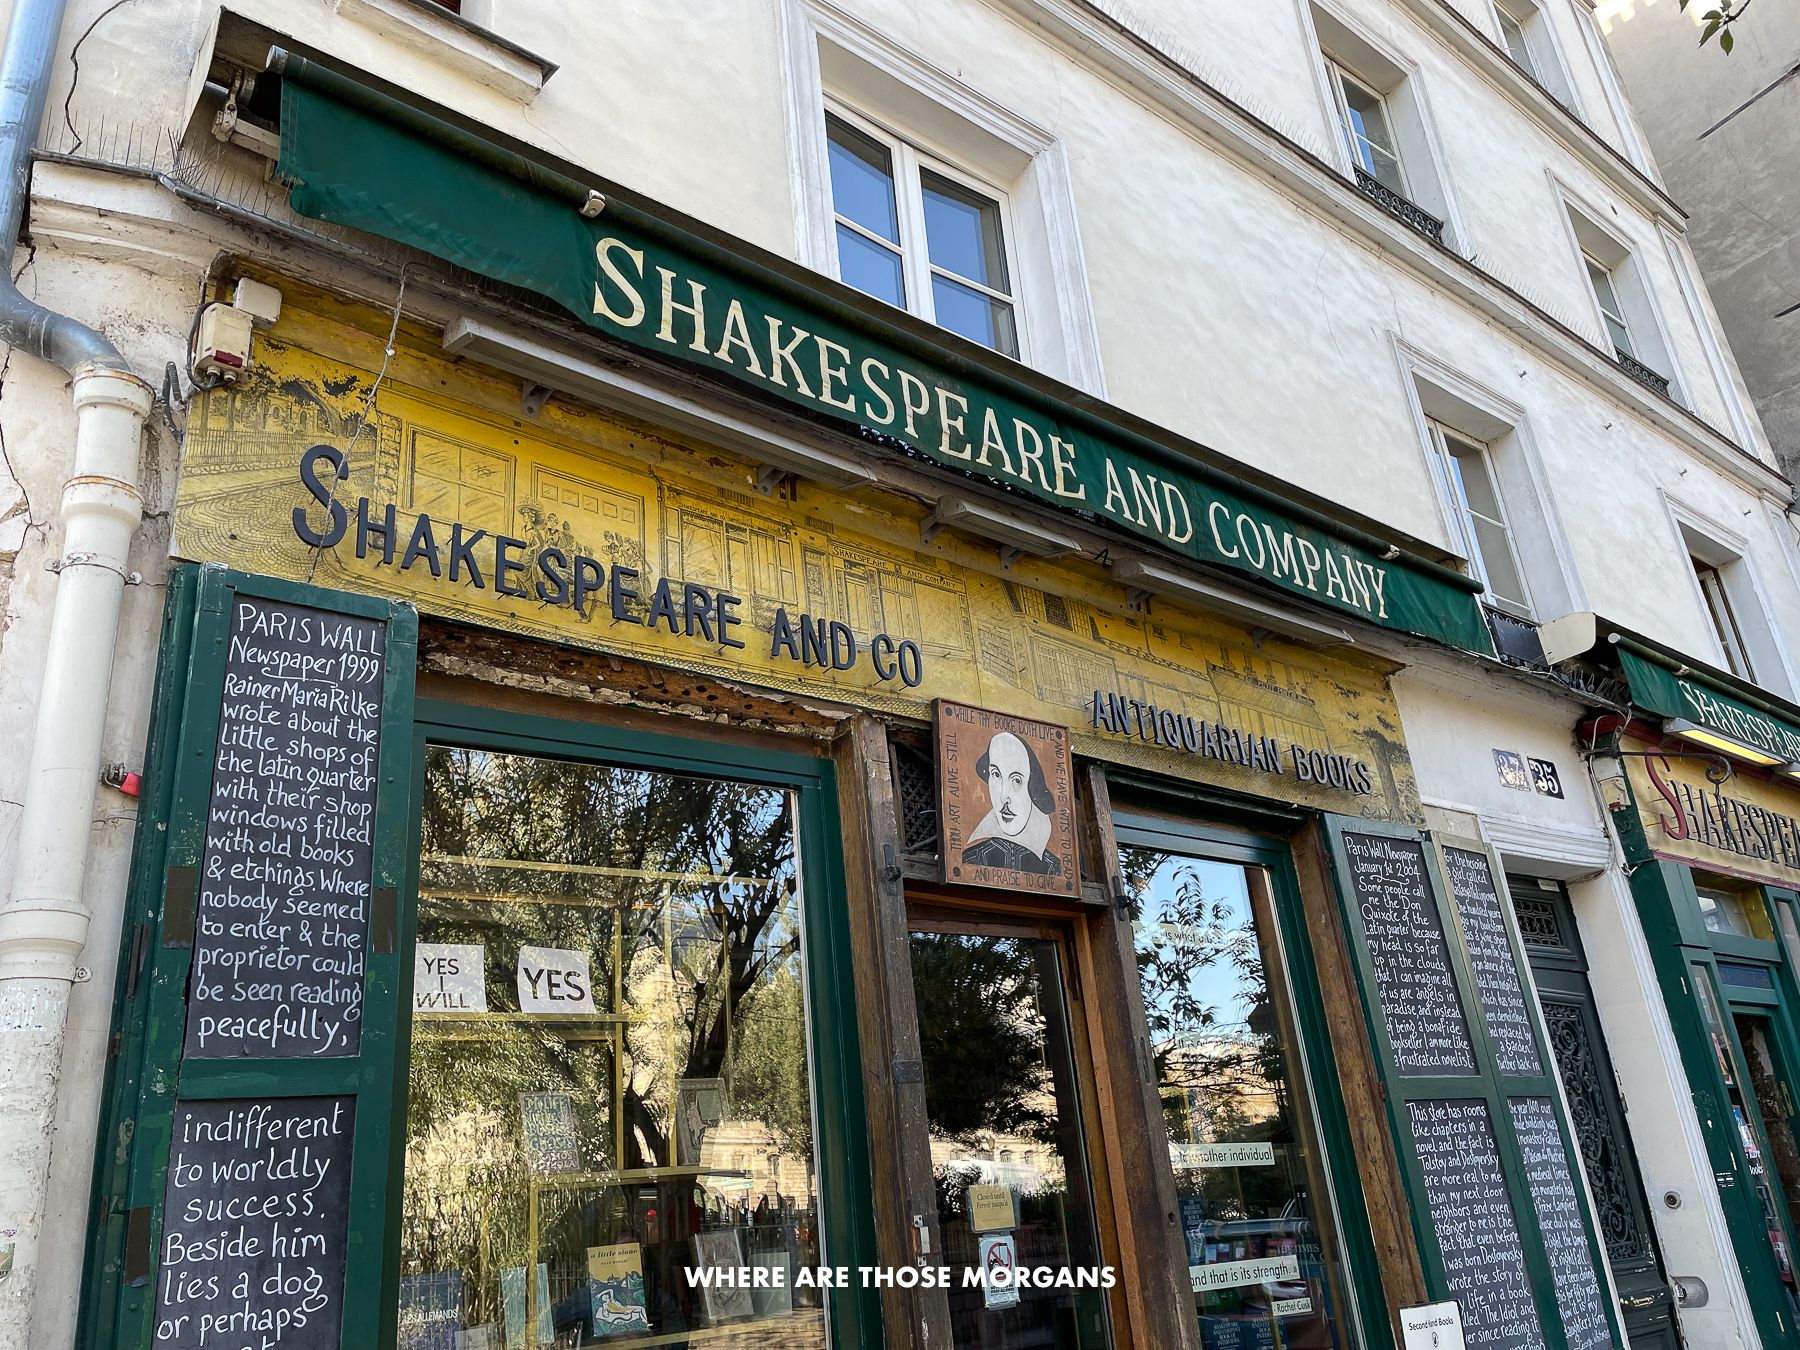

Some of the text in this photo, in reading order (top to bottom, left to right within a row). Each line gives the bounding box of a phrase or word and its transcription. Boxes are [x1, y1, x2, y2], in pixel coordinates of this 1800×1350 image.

[592, 235, 1388, 620] SHAKESPEARE AND COMPANY
[292, 444, 745, 649] SHAKESPEARE
[771, 607, 856, 671] AND
[871, 633, 924, 688] CO
[238, 603, 382, 656] PARIS WALL
[228, 635, 379, 684] Newspaper 1999
[224, 672, 379, 719] Rainer Maria Rilke
[222, 701, 378, 745] wrote about the
[953, 706, 975, 725] WHILE
[978, 712, 991, 728] THY
[1019, 721, 1038, 737] DOTH
[221, 723, 375, 777] little shops of
[946, 732, 957, 763] STILL
[1093, 690, 1374, 796] ANTIQUARIAN BOOKS
[217, 749, 376, 795] the latin quarter
[947, 766, 960, 798] ALIVE
[1528, 759, 1559, 794] 35
[216, 776, 372, 826] with their shop
[212, 805, 371, 846] windows filled
[208, 827, 354, 867] with old books
[1345, 836, 1369, 857] Paris
[1366, 839, 1385, 858] Wall
[207, 855, 370, 897] & etchings. Where
[992, 869, 1020, 887] PRAISE
[1024, 875, 1034, 888] TO
[1354, 856, 1383, 882] January
[1396, 863, 1421, 882] 2004
[201, 884, 366, 923] nobody seemed
[1359, 876, 1426, 899] Some people call
[1383, 894, 1400, 909] the
[1401, 895, 1422, 910] Don
[1361, 903, 1400, 922] Quixote
[1412, 911, 1429, 925] the
[201, 915, 361, 949] to enter & the
[198, 945, 364, 979] proprietor could
[423, 957, 460, 975] YES
[1374, 952, 1446, 972] up in the clouds
[196, 973, 362, 1022] be seen reading
[416, 992, 471, 1009] WILL
[439, 976, 445, 992] I
[523, 967, 586, 1002] YES
[197, 1004, 348, 1054] peacefully,
[1398, 1047, 1441, 1071] frustrated
[182, 1101, 344, 1149] indifferent
[1405, 1101, 1487, 1121] This store has rooms
[174, 1146, 331, 1192] to worldly
[1229, 1147, 1273, 1161] individual
[183, 1191, 325, 1223] success.
[1431, 1200, 1510, 1226] neighbors and even
[162, 1221, 327, 1266] Beside him
[163, 1262, 329, 1313] lies a dog
[1189, 1261, 1291, 1287] and that is its strength.
[1447, 1262, 1524, 1292] wrote the story of
[156, 1315, 189, 1340] or
[199, 1300, 308, 1346] perhaps
[1276, 1299, 1311, 1313] Rachel Cusk
[1438, 1317, 1454, 1326] Books
